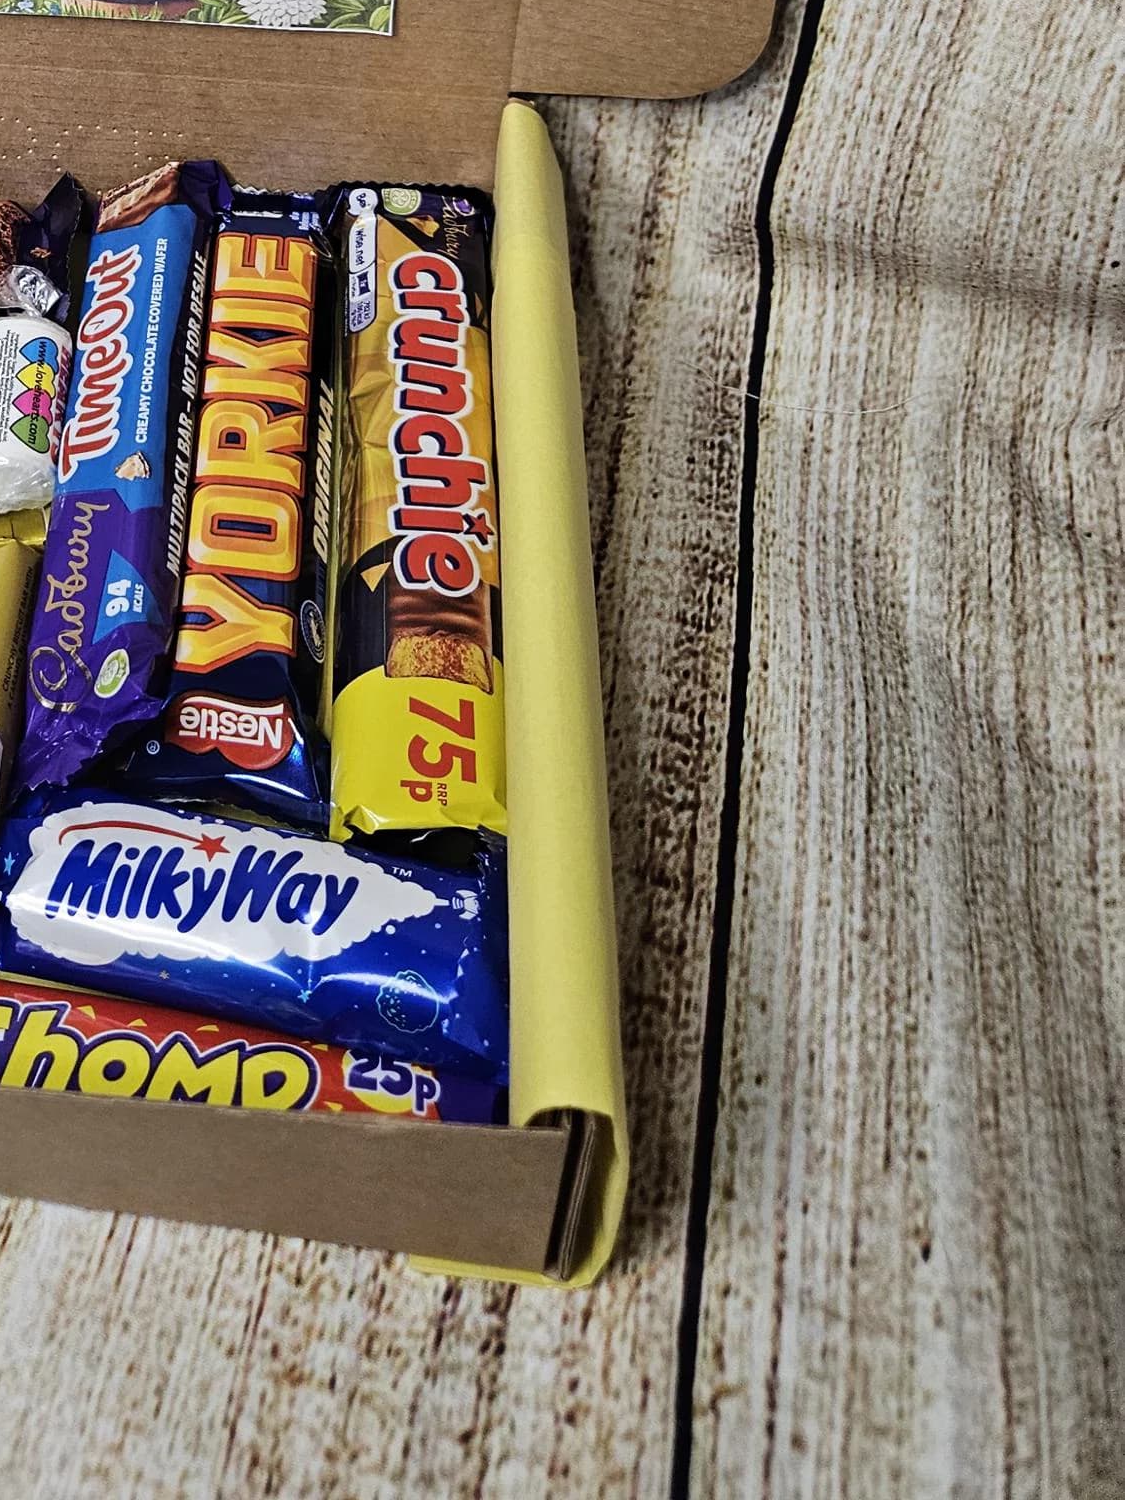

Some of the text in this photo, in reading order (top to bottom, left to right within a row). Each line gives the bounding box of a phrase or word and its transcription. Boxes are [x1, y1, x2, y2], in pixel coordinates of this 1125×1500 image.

[135, 238, 168, 443] CREAMY CHOCOLATE COVERED WAFER
[192, 251, 208, 326] RESALE
[28, 340, 48, 445] www.lovehearts.com
[58, 245, 141, 482] TimeOut
[182, 362, 199, 398] NOT
[188, 326, 205, 362] FOR
[176, 234, 316, 672] YORKIE
[178, 412, 194, 456] BAR
[313, 379, 333, 565] ORIGINAL
[388, 252, 495, 596] Crunchie
[166, 457, 190, 577] MULTIPACK
[29, 501, 110, 712] Cadbury
[106, 578, 131, 618] 94
[133, 583, 144, 614] KCALS
[400, 697, 478, 803] 75p
[436, 782, 447, 806] RRP
[346, 1051, 437, 1113] 25p
